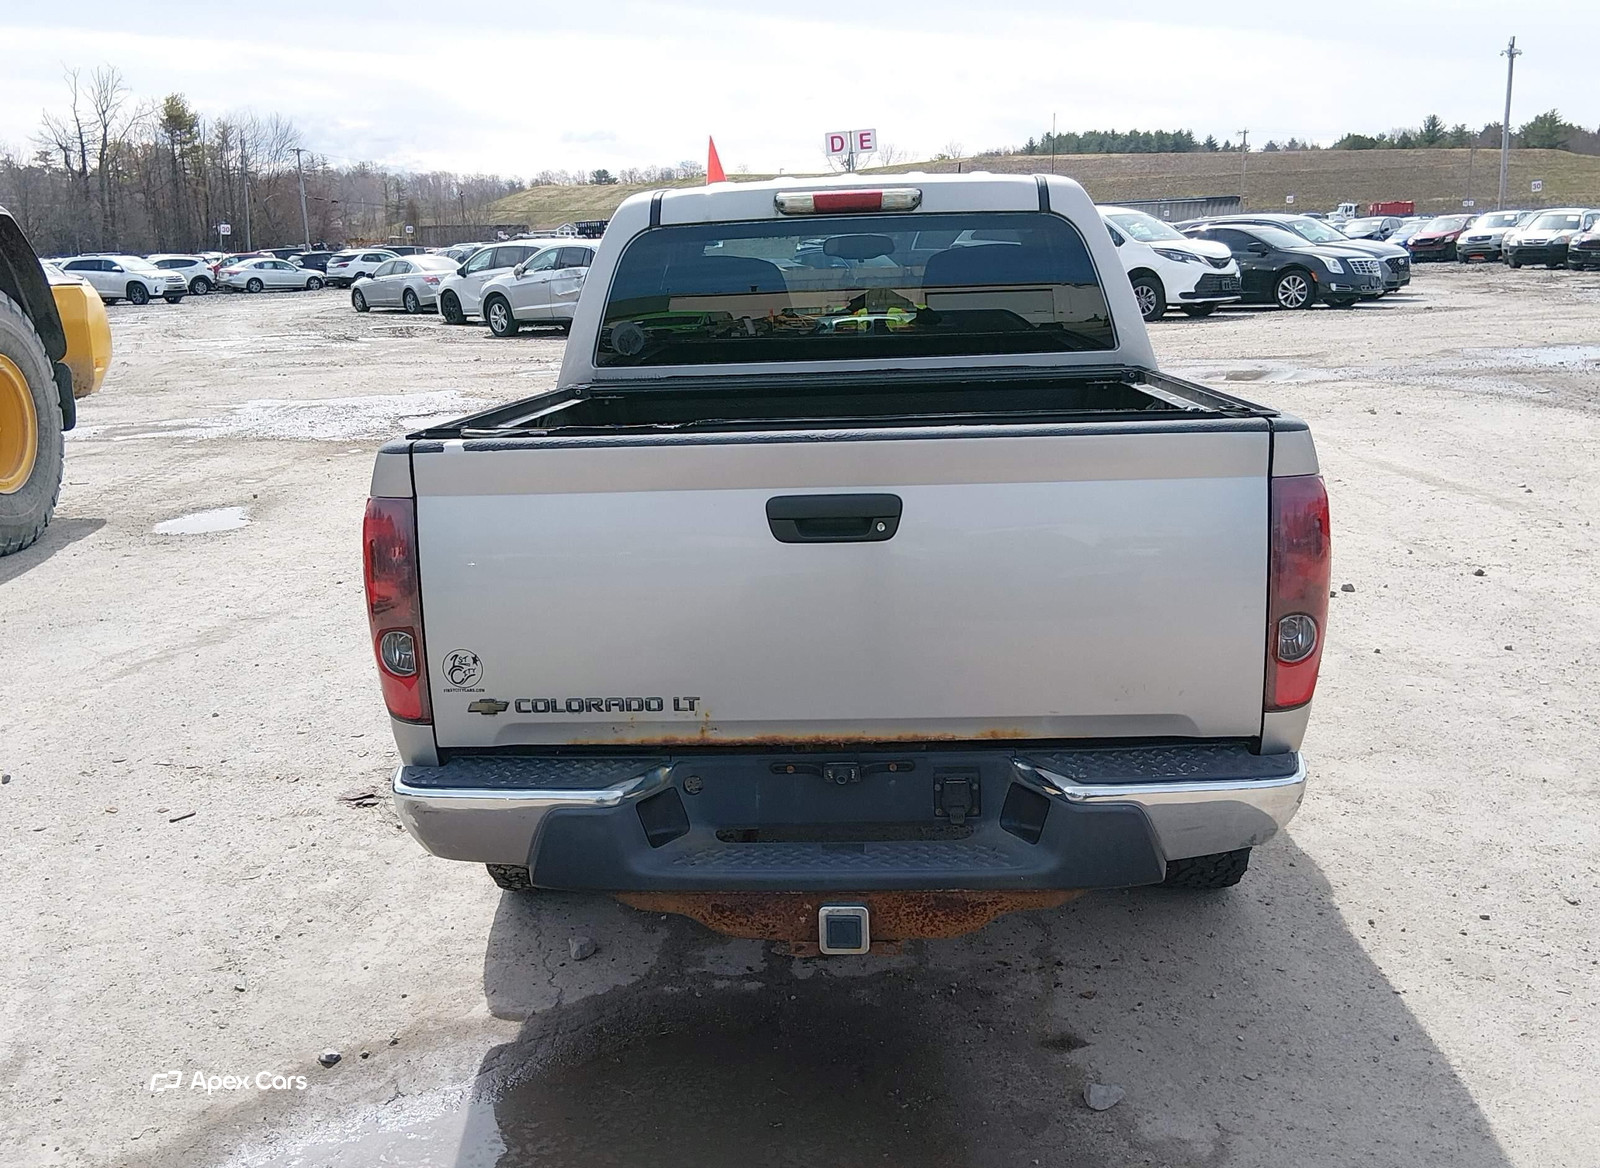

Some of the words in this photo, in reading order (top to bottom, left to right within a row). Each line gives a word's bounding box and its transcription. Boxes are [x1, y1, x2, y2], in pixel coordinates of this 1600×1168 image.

[830, 135, 845, 153] D
[859, 132, 872, 150] E
[514, 697, 664, 713] COLORADO
[673, 696, 700, 712] LT
